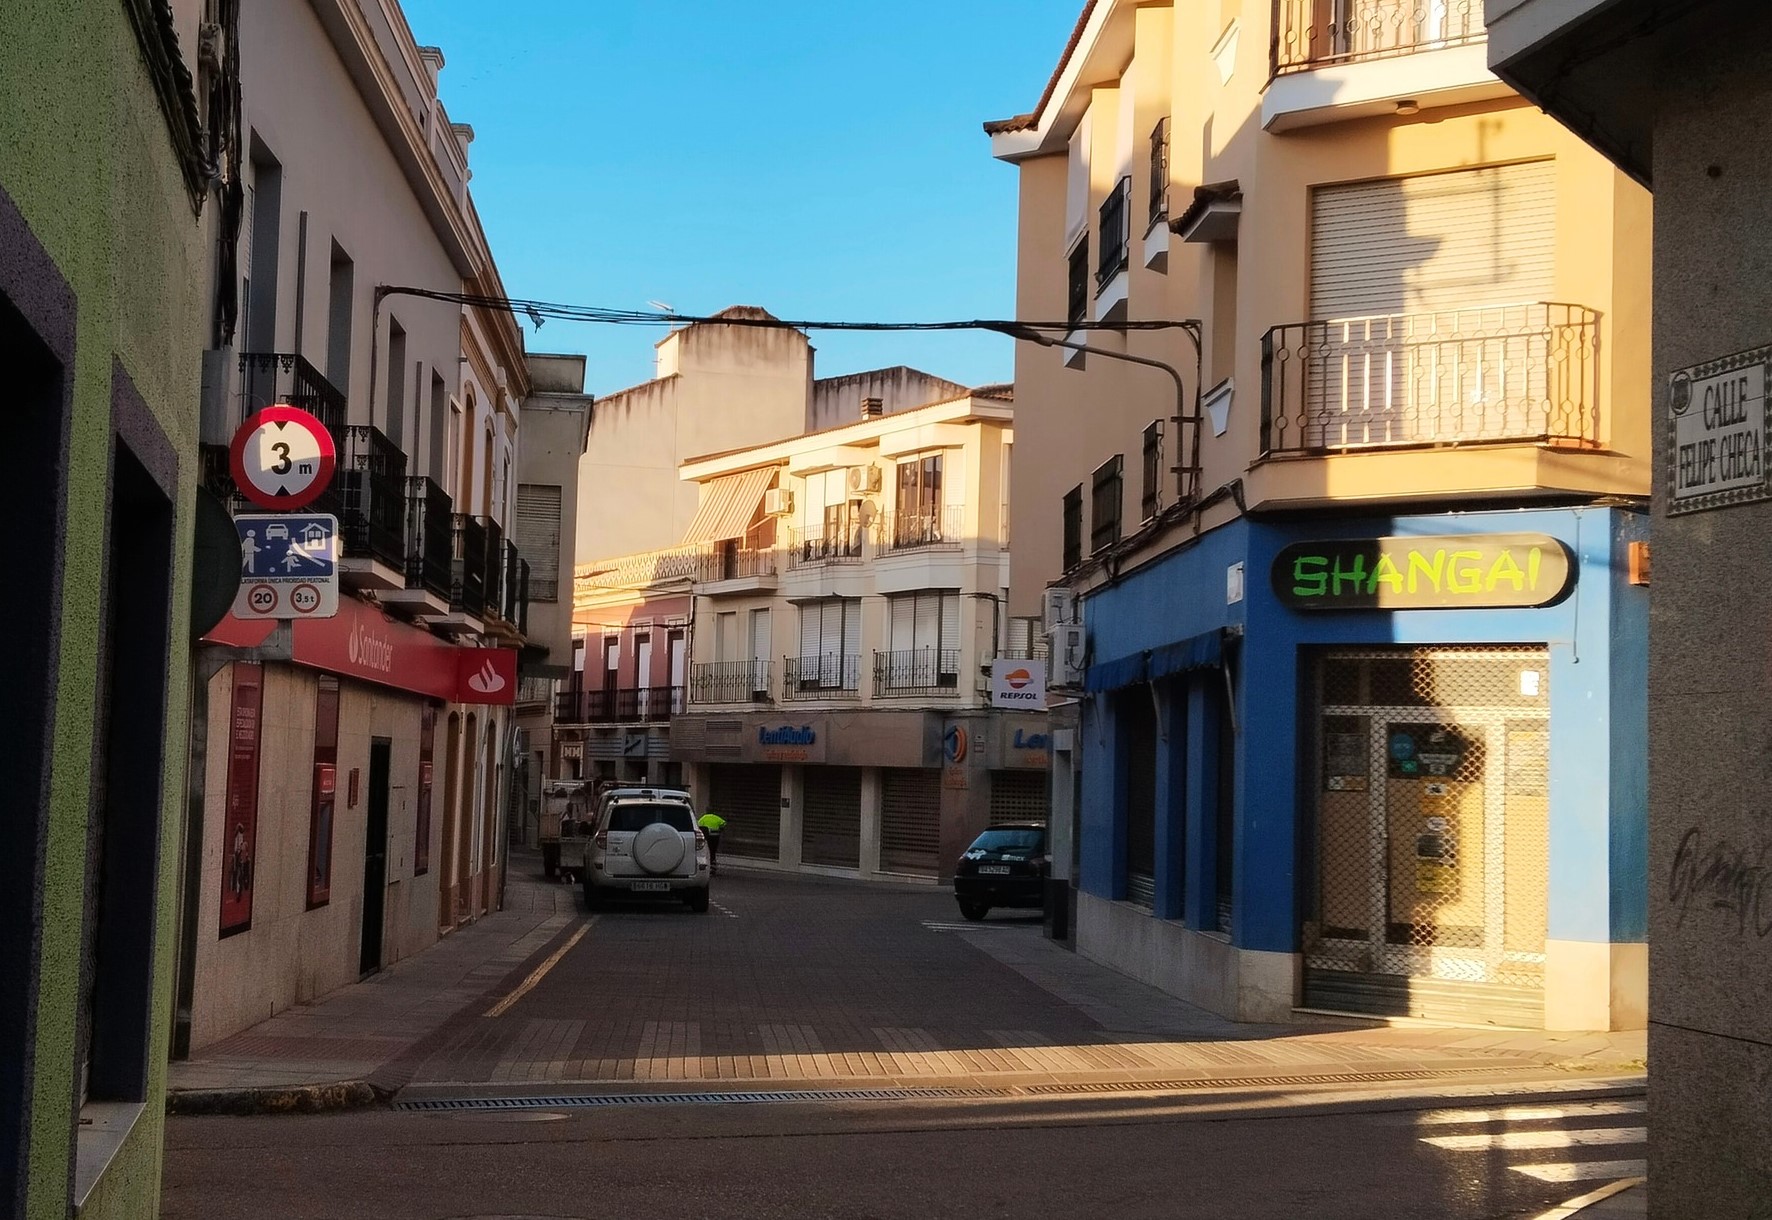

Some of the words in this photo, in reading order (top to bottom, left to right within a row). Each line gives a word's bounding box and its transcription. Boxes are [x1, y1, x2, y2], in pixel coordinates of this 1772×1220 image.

[1704, 376, 1748, 431] CALLE
[271, 442, 293, 476] 3
[299, 463, 313, 475] m
[1678, 438, 1717, 490] FELIPE
[1720, 428, 1760, 482] CHECA
[1292, 547, 1542, 596] SHANGAI
[254, 592, 273, 604] 20
[358, 624, 394, 673] Santander
[1000, 692, 1037, 700] REPSOL
